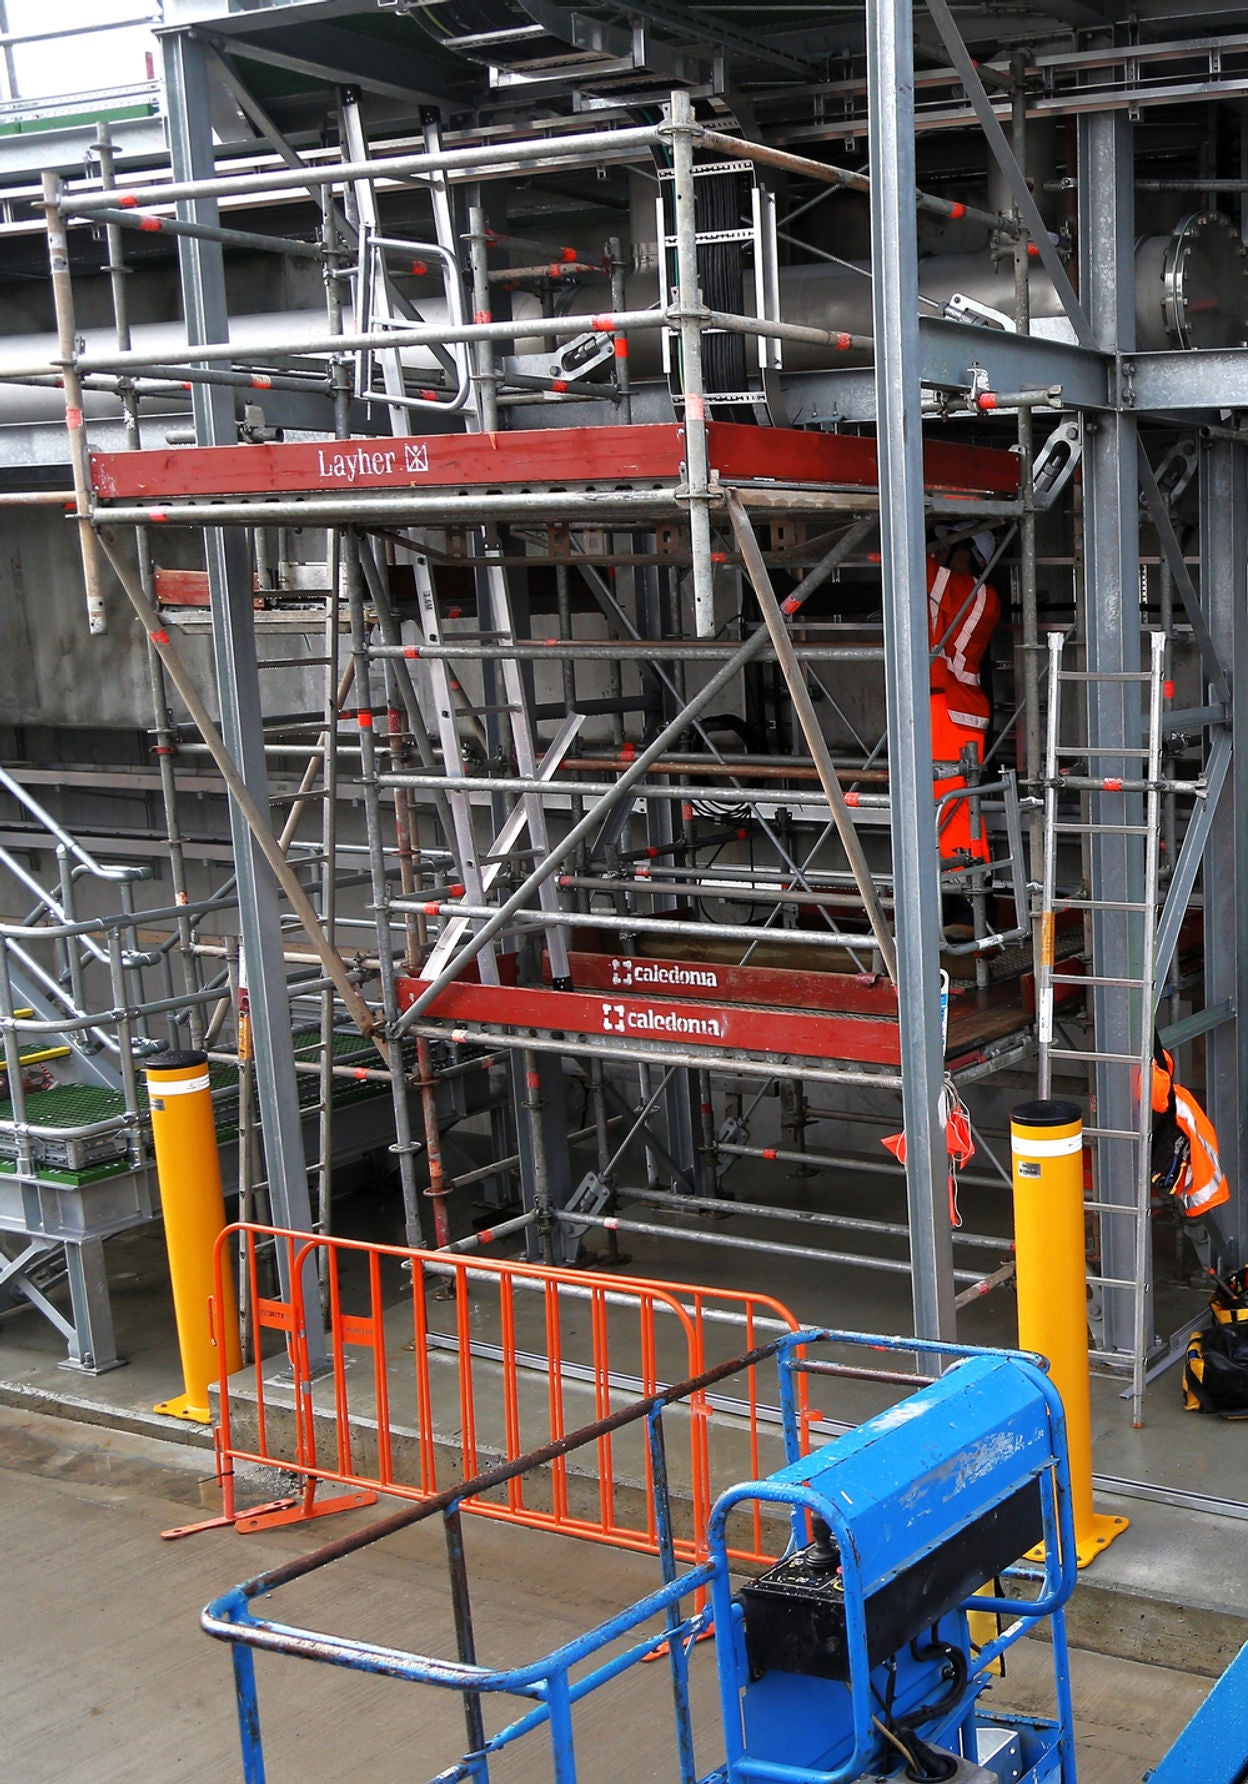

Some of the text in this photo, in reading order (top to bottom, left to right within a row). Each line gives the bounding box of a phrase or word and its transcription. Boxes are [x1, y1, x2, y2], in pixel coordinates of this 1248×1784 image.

[318, 447, 396, 482] Layher
[634, 964, 718, 987] caledonia
[627, 1008, 720, 1037] caledonia
